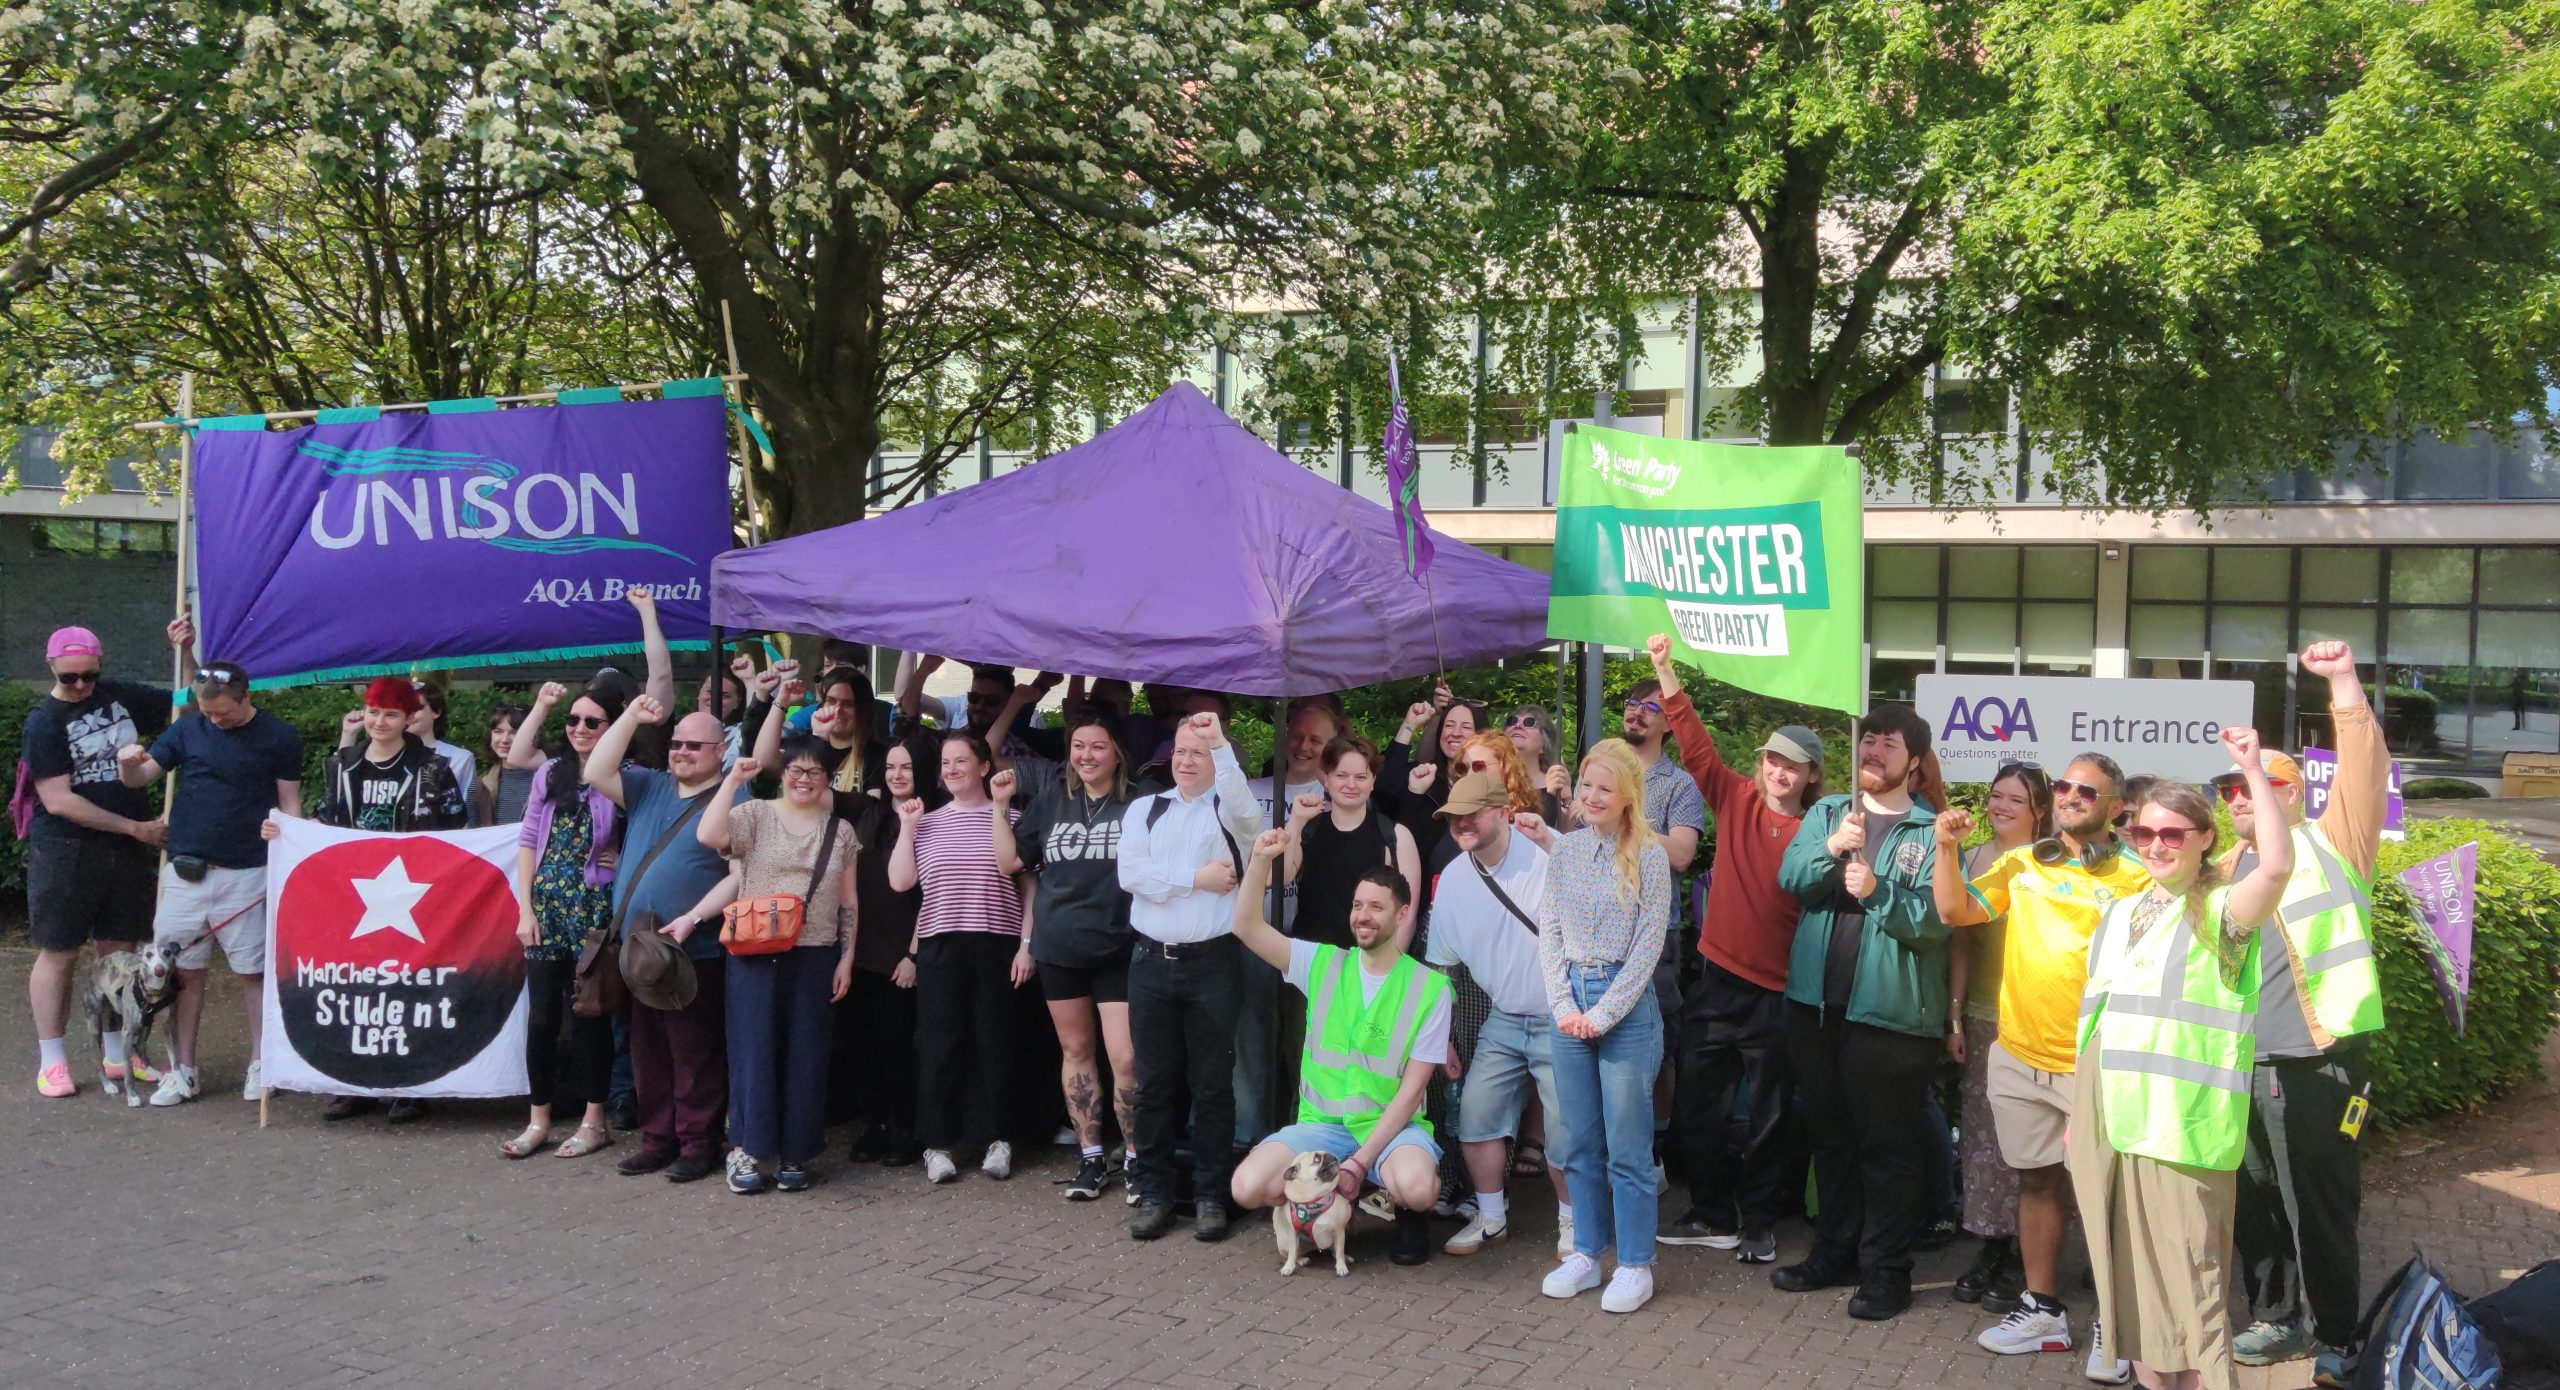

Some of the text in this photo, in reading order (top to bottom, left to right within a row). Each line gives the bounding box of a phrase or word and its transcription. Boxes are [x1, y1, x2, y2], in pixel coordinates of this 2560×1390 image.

[1643, 457, 1681, 490] Party
[311, 472, 639, 549] UNISON
[523, 577, 595, 607] AQA
[1674, 608, 1769, 647] GREEN PARTY
[1941, 696, 2039, 742] AQA
[2071, 711, 2221, 744] Entrance
[1939, 747, 2039, 759] Questions matter
[2434, 860, 2466, 924] UNISON
[352, 1025, 409, 1056] Left
